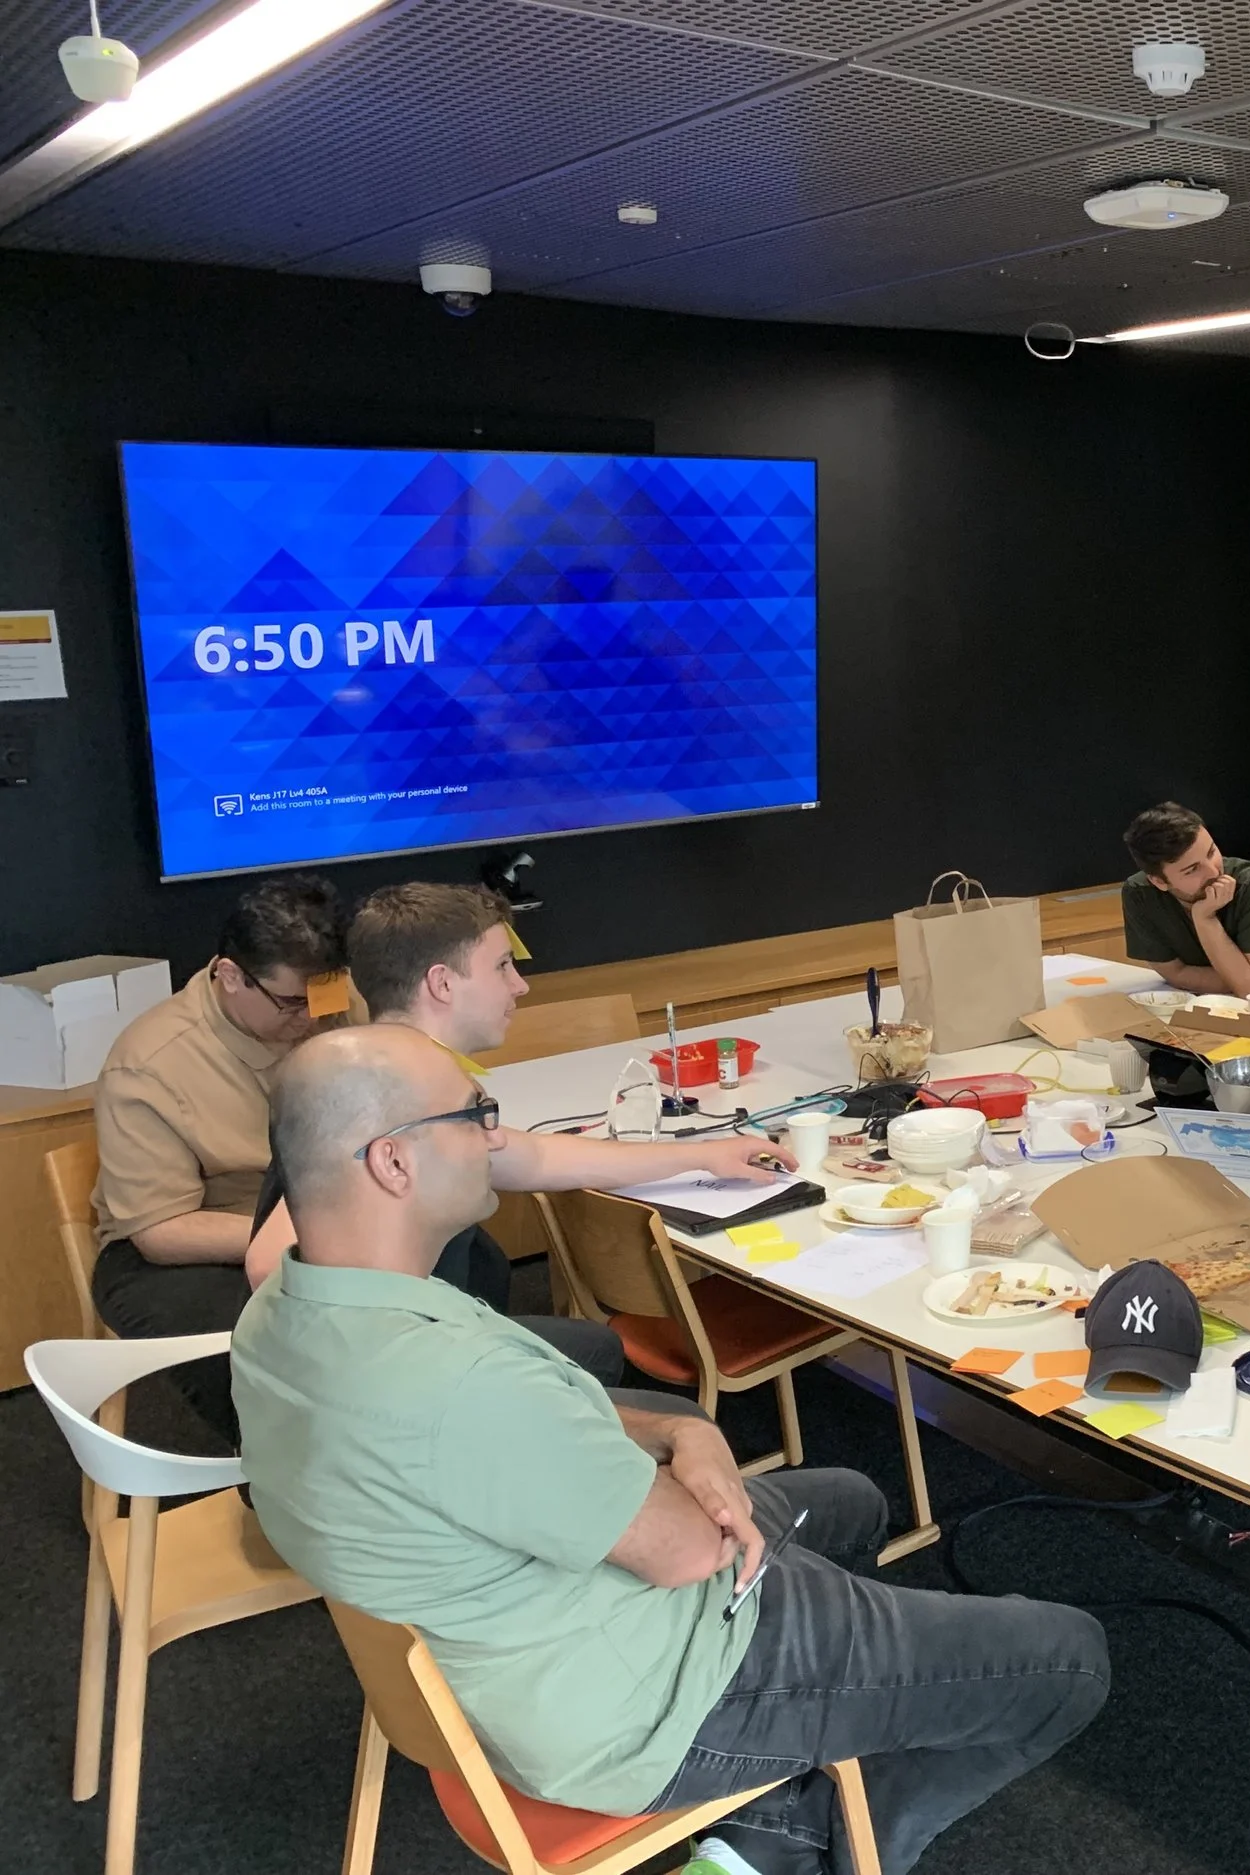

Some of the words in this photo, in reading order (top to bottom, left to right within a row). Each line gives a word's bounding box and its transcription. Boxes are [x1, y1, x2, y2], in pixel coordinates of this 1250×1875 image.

[194, 622, 324, 673] 6:50
[344, 619, 435, 666] PM
[249, 792, 271, 802] Kens
[272, 790, 287, 800] J17
[305, 786, 328, 797] 405A
[250, 803, 269, 812] Add
[271, 801, 287, 810] this
[289, 800, 312, 809] room
[314, 798, 324, 806] to
[333, 793, 367, 804] meeting
[368, 791, 386, 801] with
[387, 791, 406, 801] your
[407, 785, 441, 799] personal
[442, 784, 468, 794] device
[1121, 1294, 1159, 1334] NY
